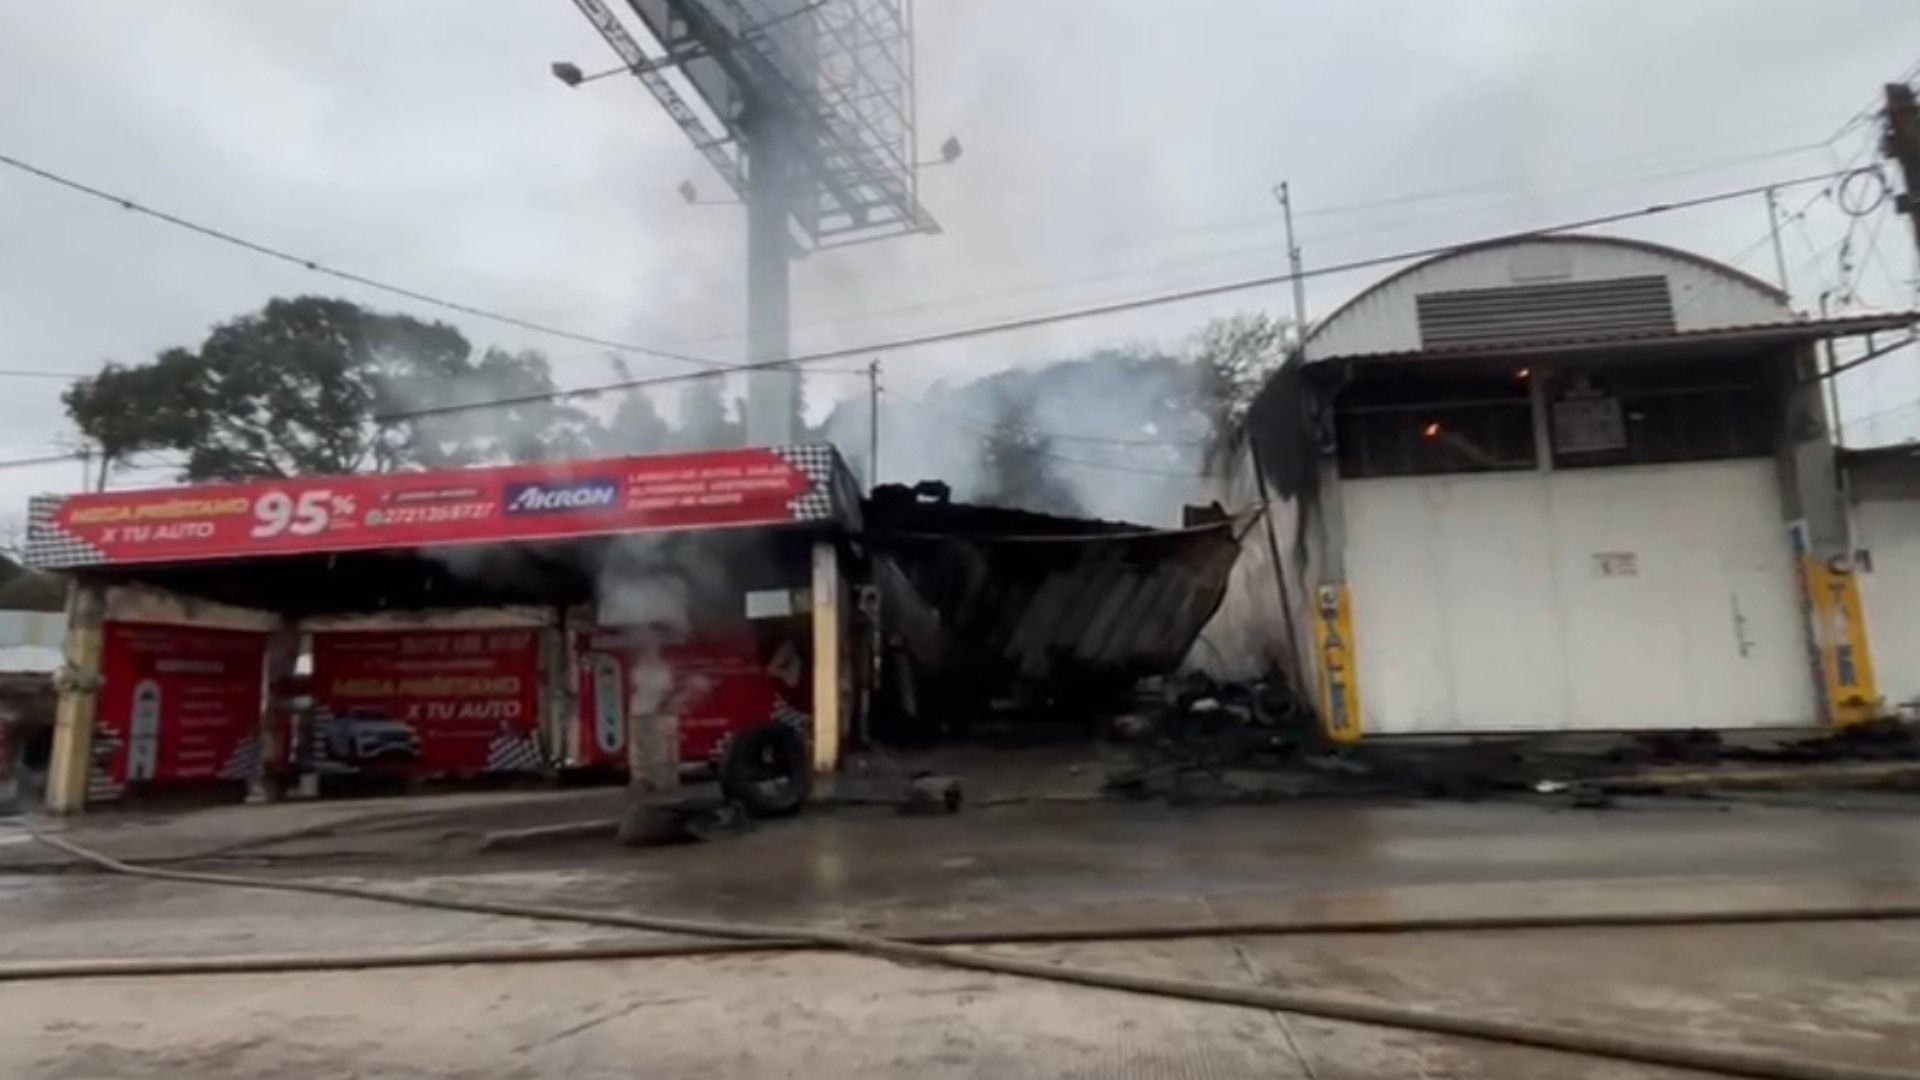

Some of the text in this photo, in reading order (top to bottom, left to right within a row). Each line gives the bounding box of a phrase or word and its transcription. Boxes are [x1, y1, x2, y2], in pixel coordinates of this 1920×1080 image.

[507, 486, 615, 511] AKRON
[102, 521, 215, 543] X TU AUTO
[406, 701, 521, 718] X TU AUTO
